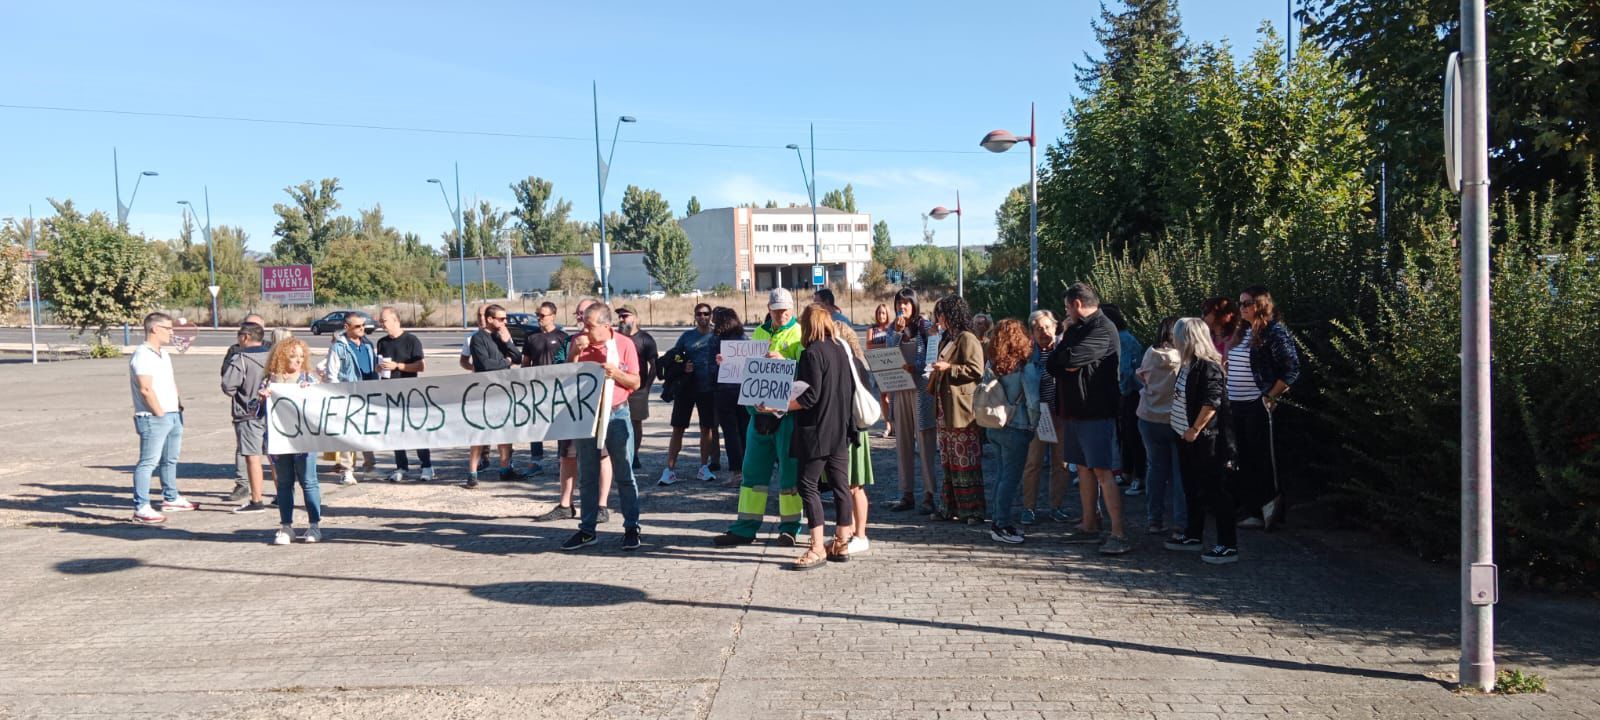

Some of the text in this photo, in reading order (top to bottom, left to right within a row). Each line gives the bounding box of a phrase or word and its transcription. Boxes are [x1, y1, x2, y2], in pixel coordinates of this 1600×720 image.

[272, 268, 301, 278] SUELO
[265, 277, 308, 288] EN VENTA
[719, 363, 739, 379] SIN
[748, 360, 795, 376] QUEREMOS
[742, 377, 790, 400] COBRAR
[271, 372, 599, 438] QUEREMOS COBRAR
